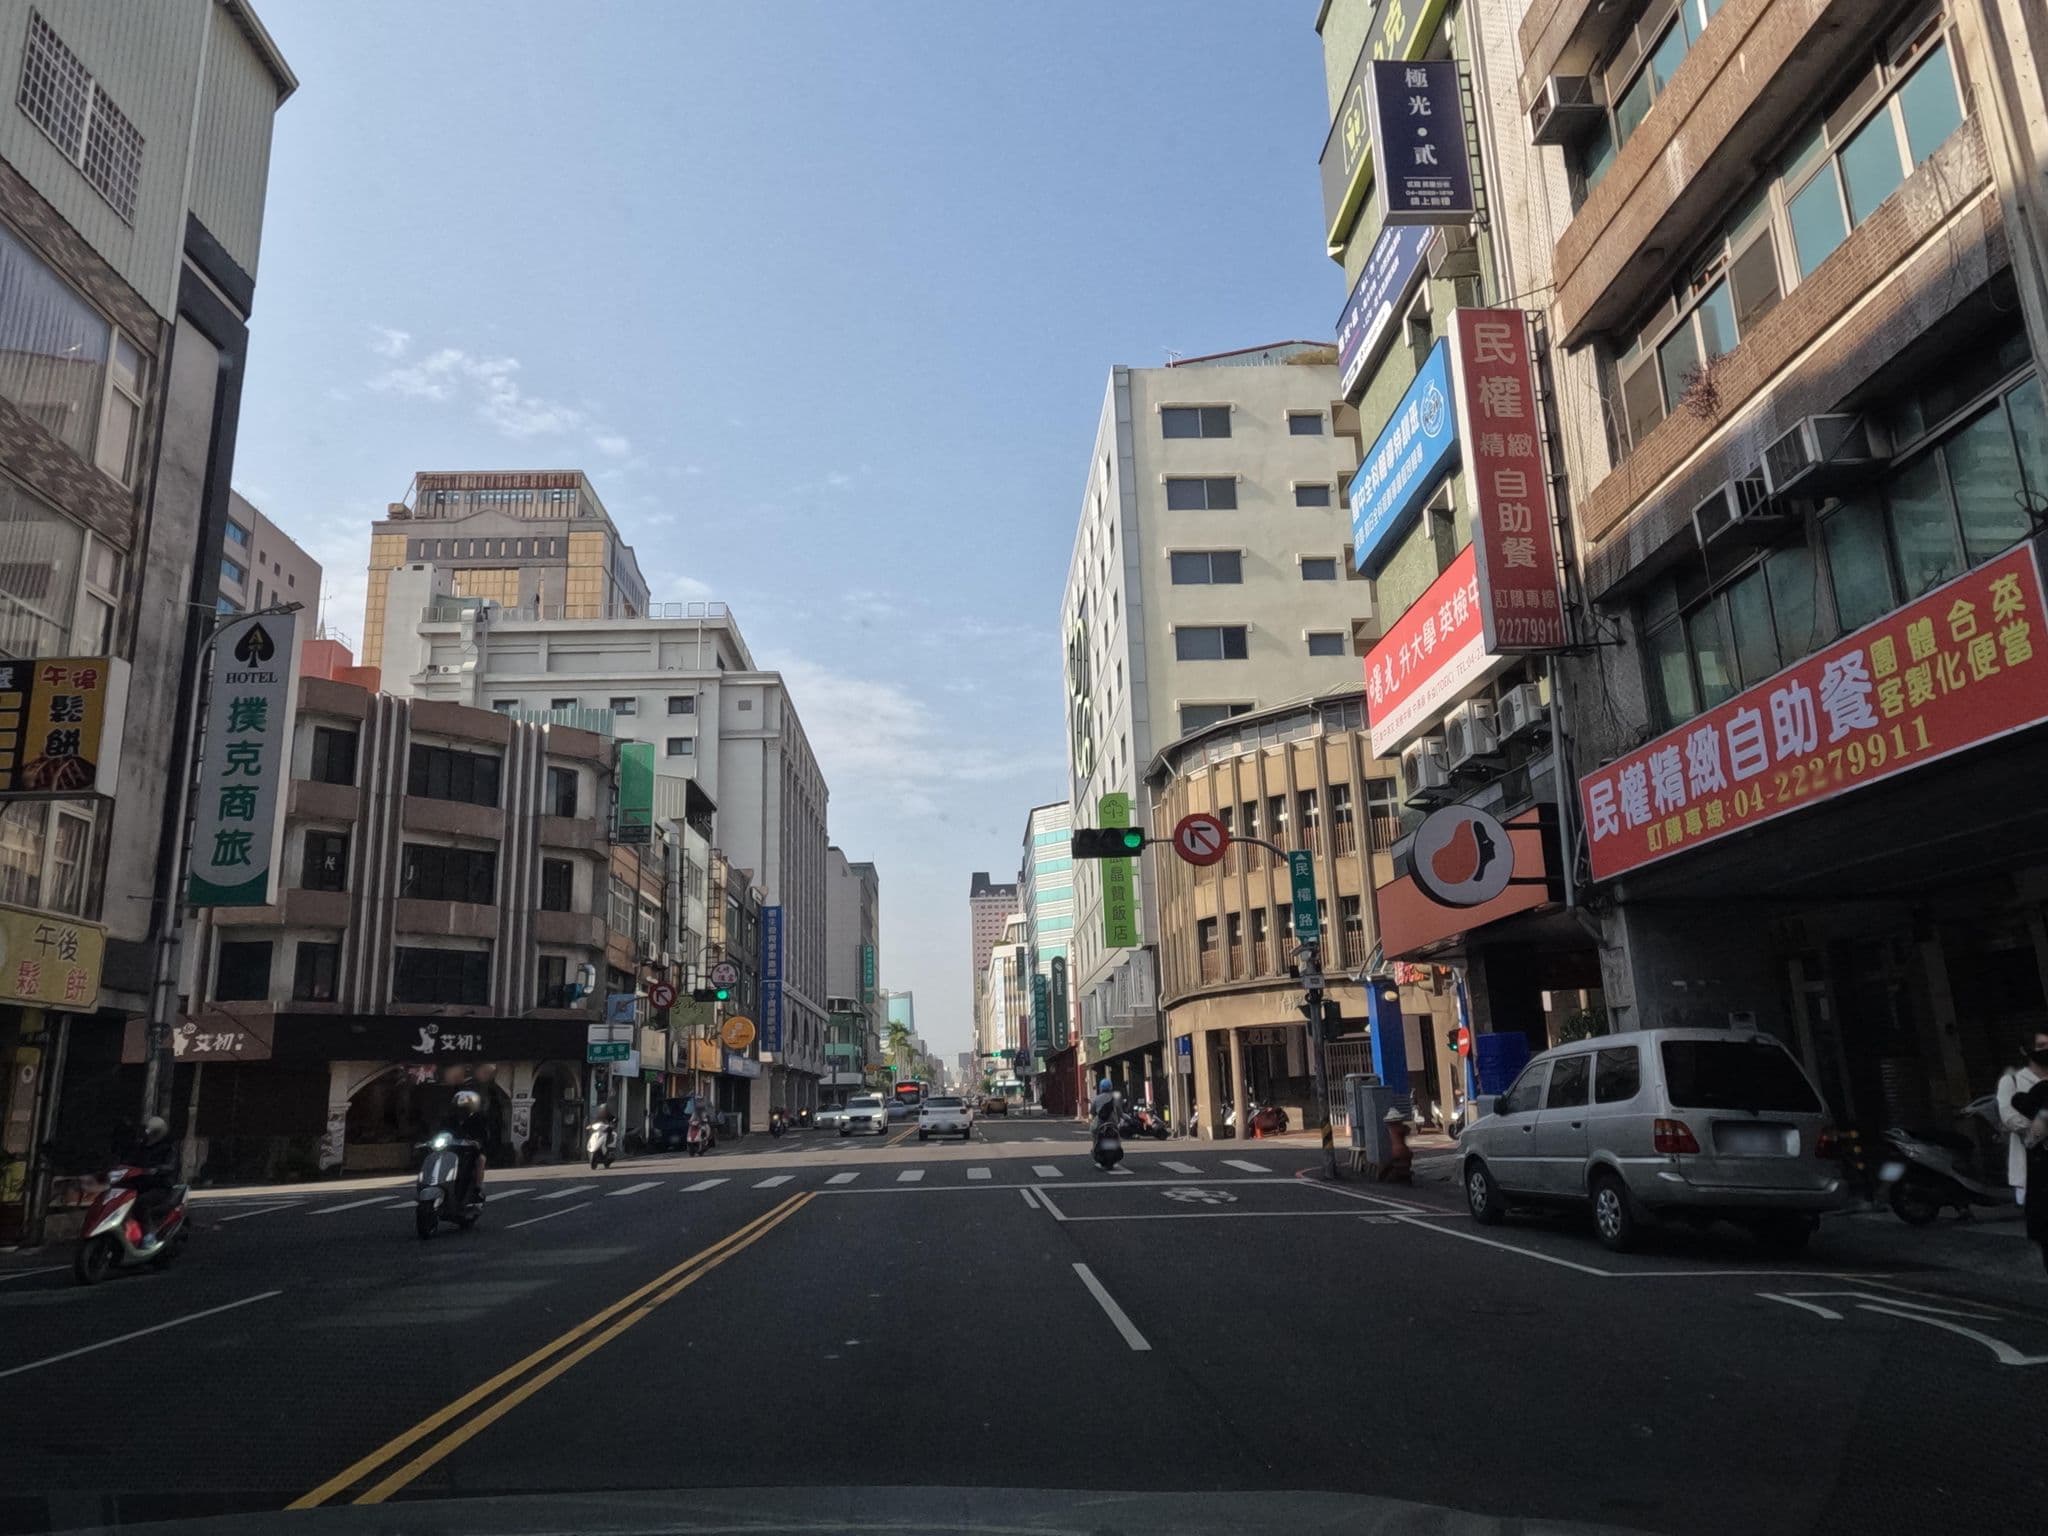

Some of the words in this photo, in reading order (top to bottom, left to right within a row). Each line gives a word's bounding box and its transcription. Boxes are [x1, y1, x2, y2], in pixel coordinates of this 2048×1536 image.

[1473, 322, 1525, 419] 民權
[1480, 432, 1536, 458] 精緻
[1493, 467, 1538, 569] 自助餐
[1495, 589, 1557, 609] 訂購專線
[1500, 617, 1560, 643] 22279911
[1869, 573, 2027, 680] 團體合菜
[225, 671, 278, 684] HOTEL
[1399, 616, 1437, 679] 升大學
[1877, 620, 2034, 720] 客製化便當
[1588, 649, 1879, 843] 民權精緻自助餐
[211, 696, 268, 867] 撲克商旅
[34, 923, 79, 962] 午後
[16, 961, 88, 1001] 鬆餅
